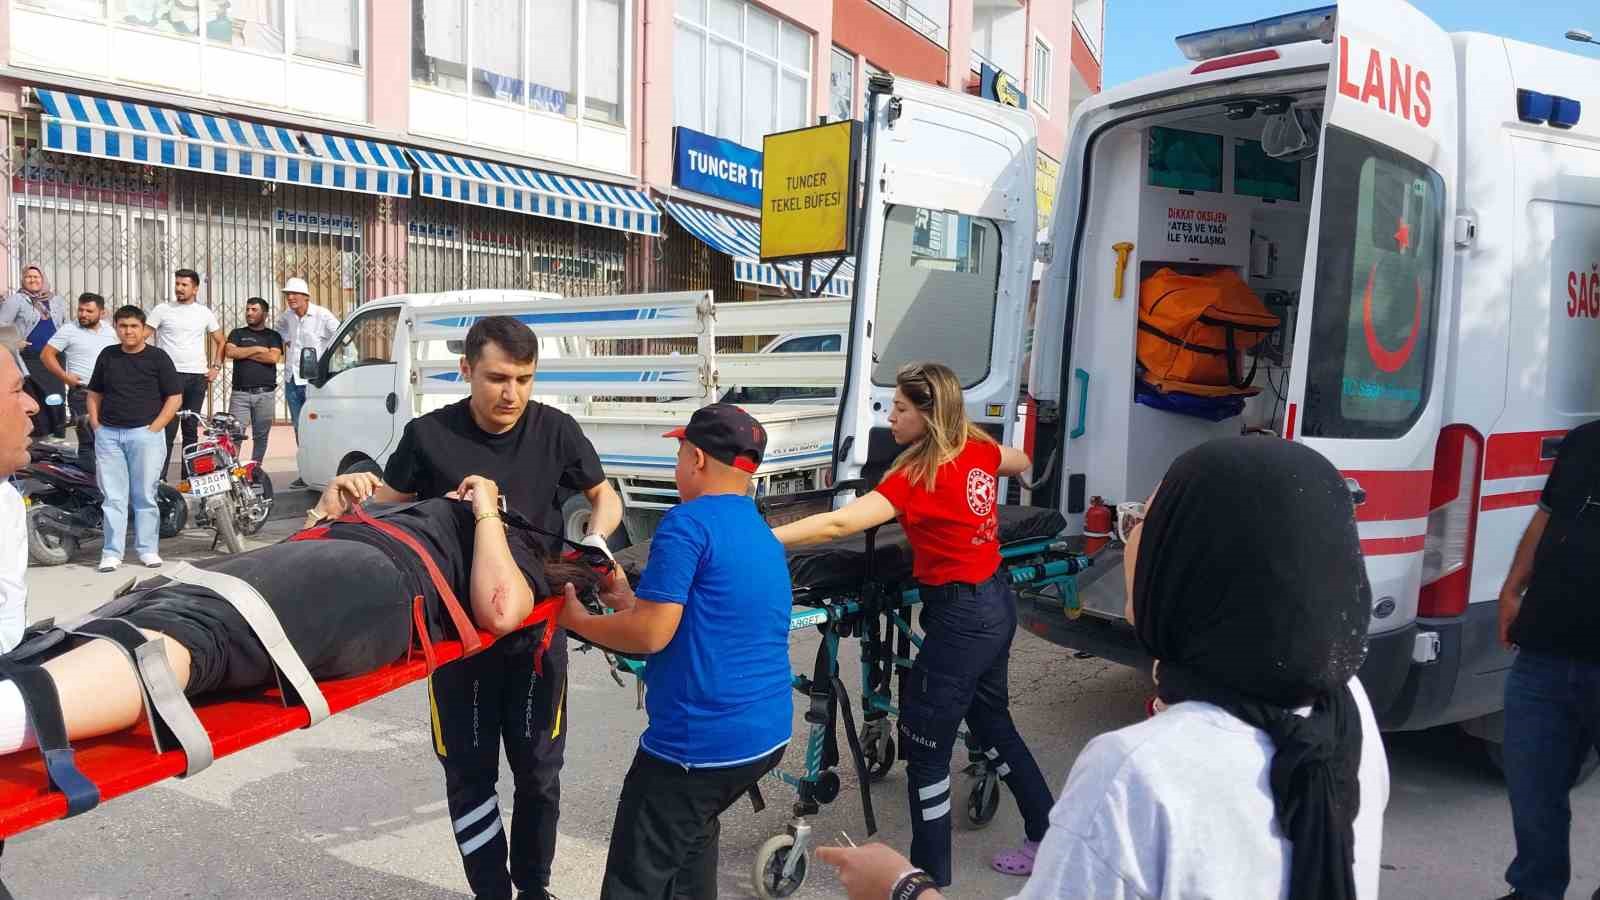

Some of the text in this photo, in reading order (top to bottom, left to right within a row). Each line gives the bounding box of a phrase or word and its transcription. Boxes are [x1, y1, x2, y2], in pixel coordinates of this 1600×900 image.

[1339, 35, 1431, 128] LANS
[687, 150, 748, 186] TUNCER
[786, 172, 828, 191] TUNCER
[771, 197, 804, 213] TEKEL
[277, 209, 359, 231] Panasonic
[1195, 223, 1206, 232] VE
